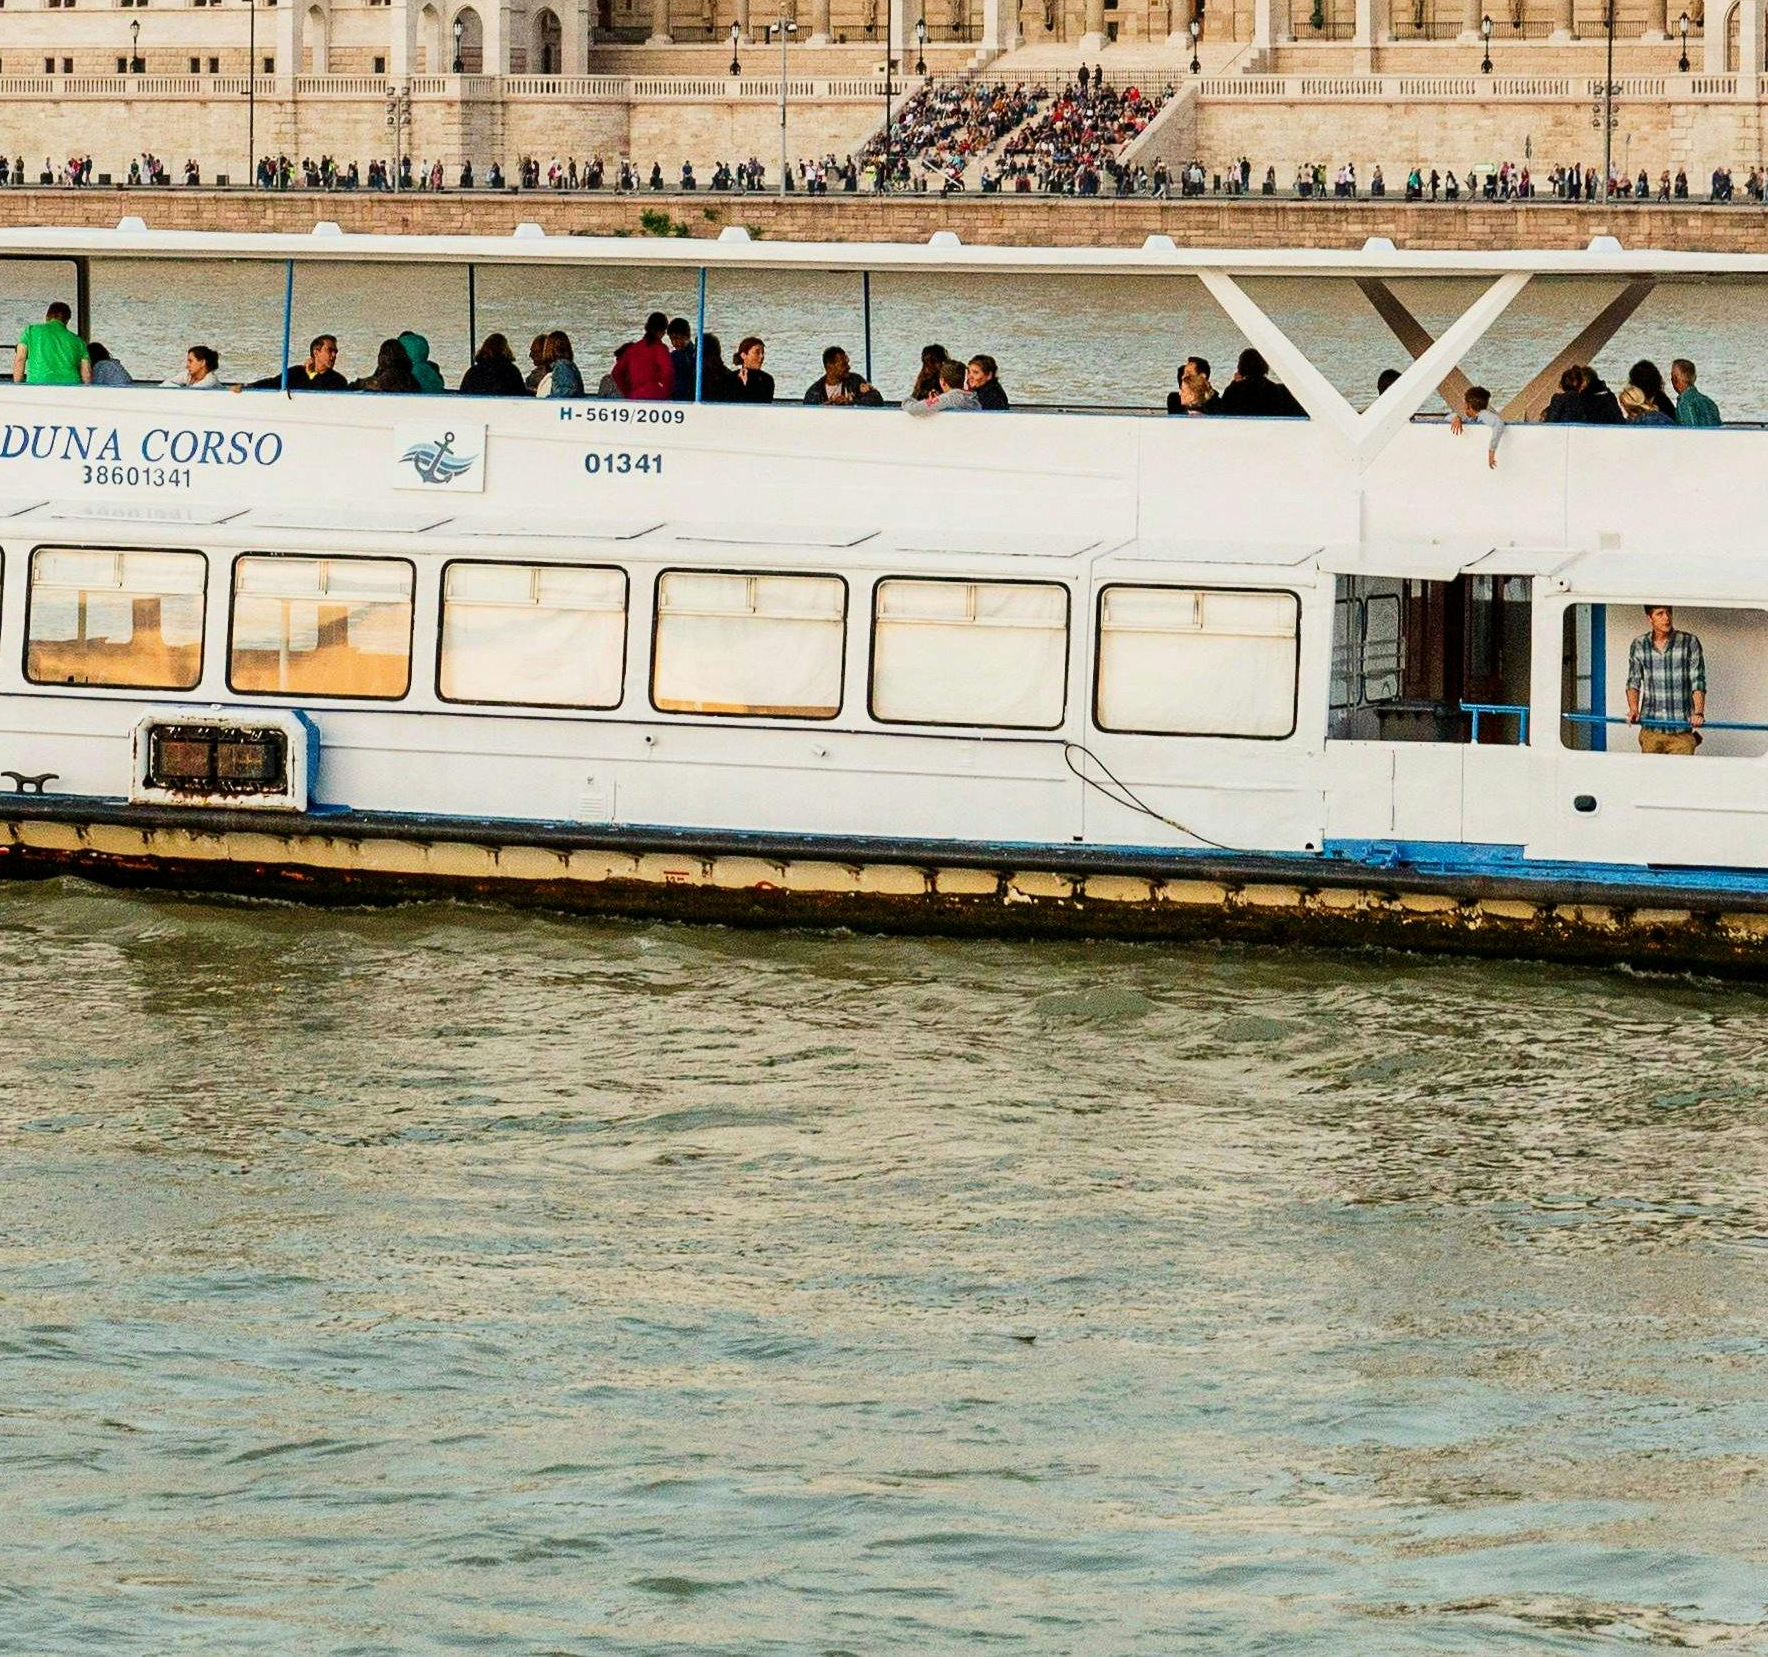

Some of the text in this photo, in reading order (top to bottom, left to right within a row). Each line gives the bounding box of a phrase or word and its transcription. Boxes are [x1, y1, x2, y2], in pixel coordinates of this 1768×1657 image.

[141, 428, 283, 466] CORSO
[584, 453, 662, 473] 01341
[83, 465, 191, 488] 38601341
